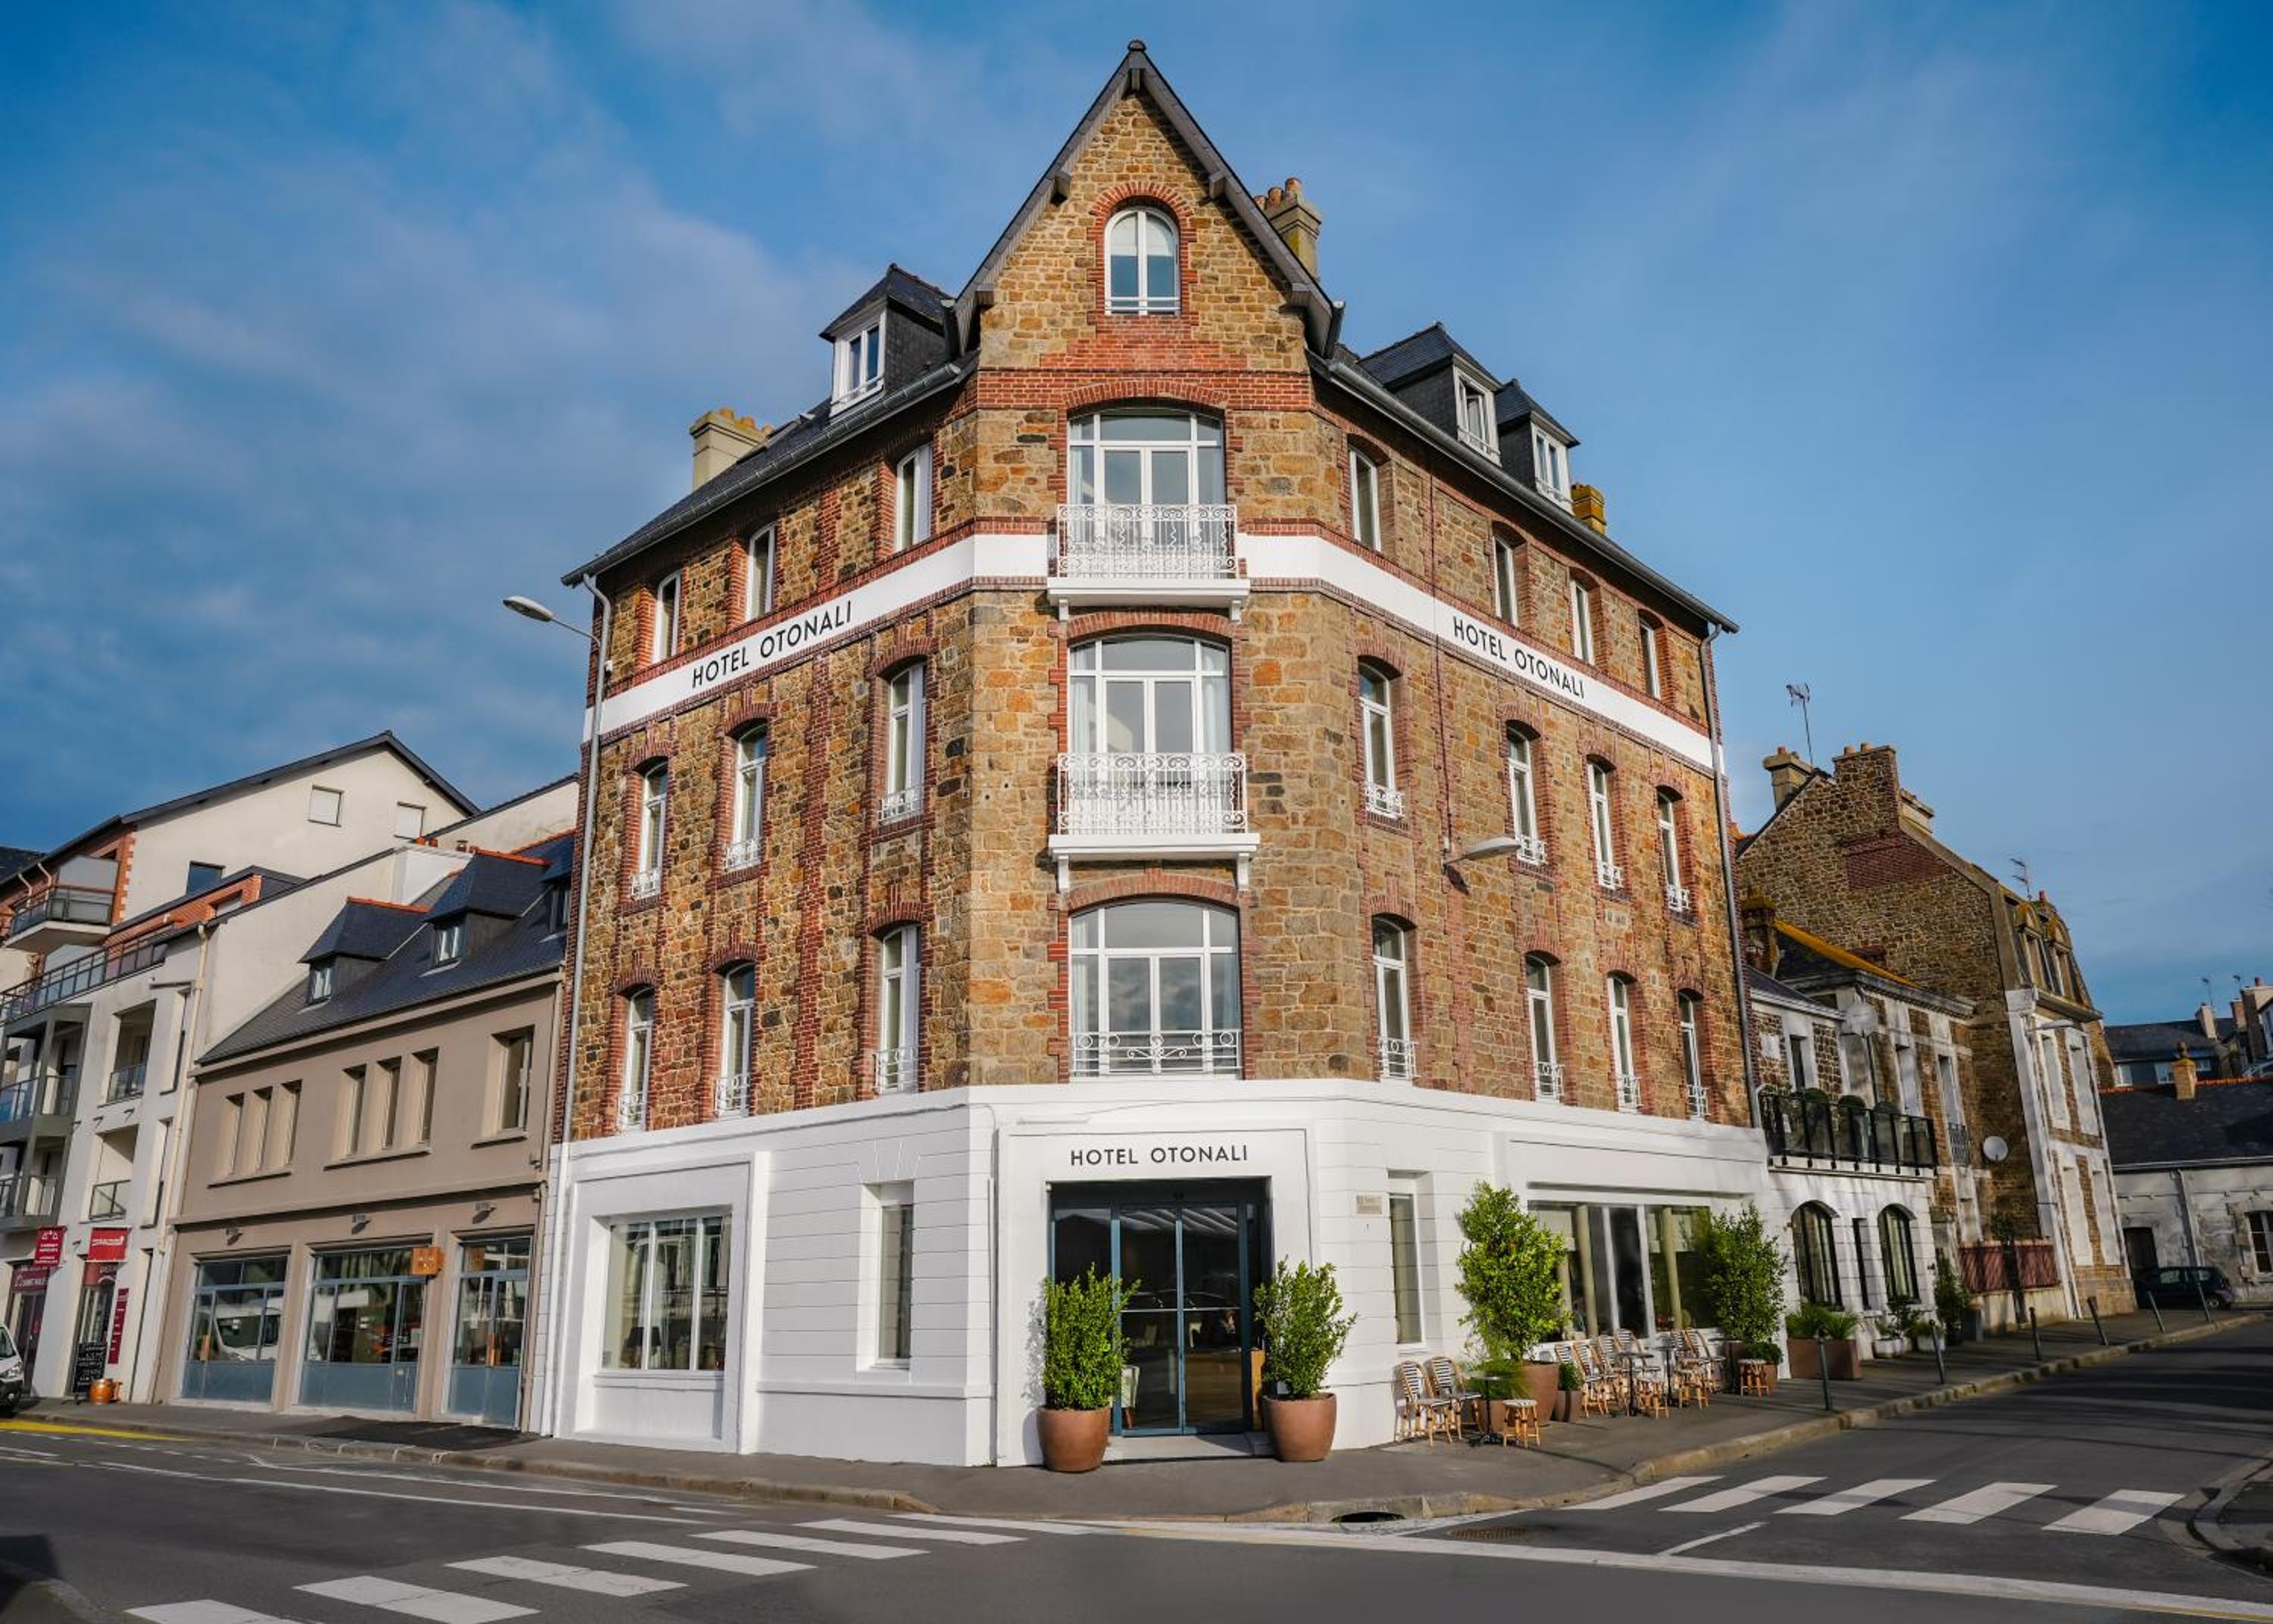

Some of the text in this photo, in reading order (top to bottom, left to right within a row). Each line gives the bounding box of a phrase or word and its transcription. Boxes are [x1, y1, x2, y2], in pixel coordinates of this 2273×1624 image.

[692, 601, 851, 688] HOTEL OTONALI
[1452, 616, 1584, 698] HOTEL OTONALI
[1071, 1145, 1248, 1166] HOTEL OTONALI
